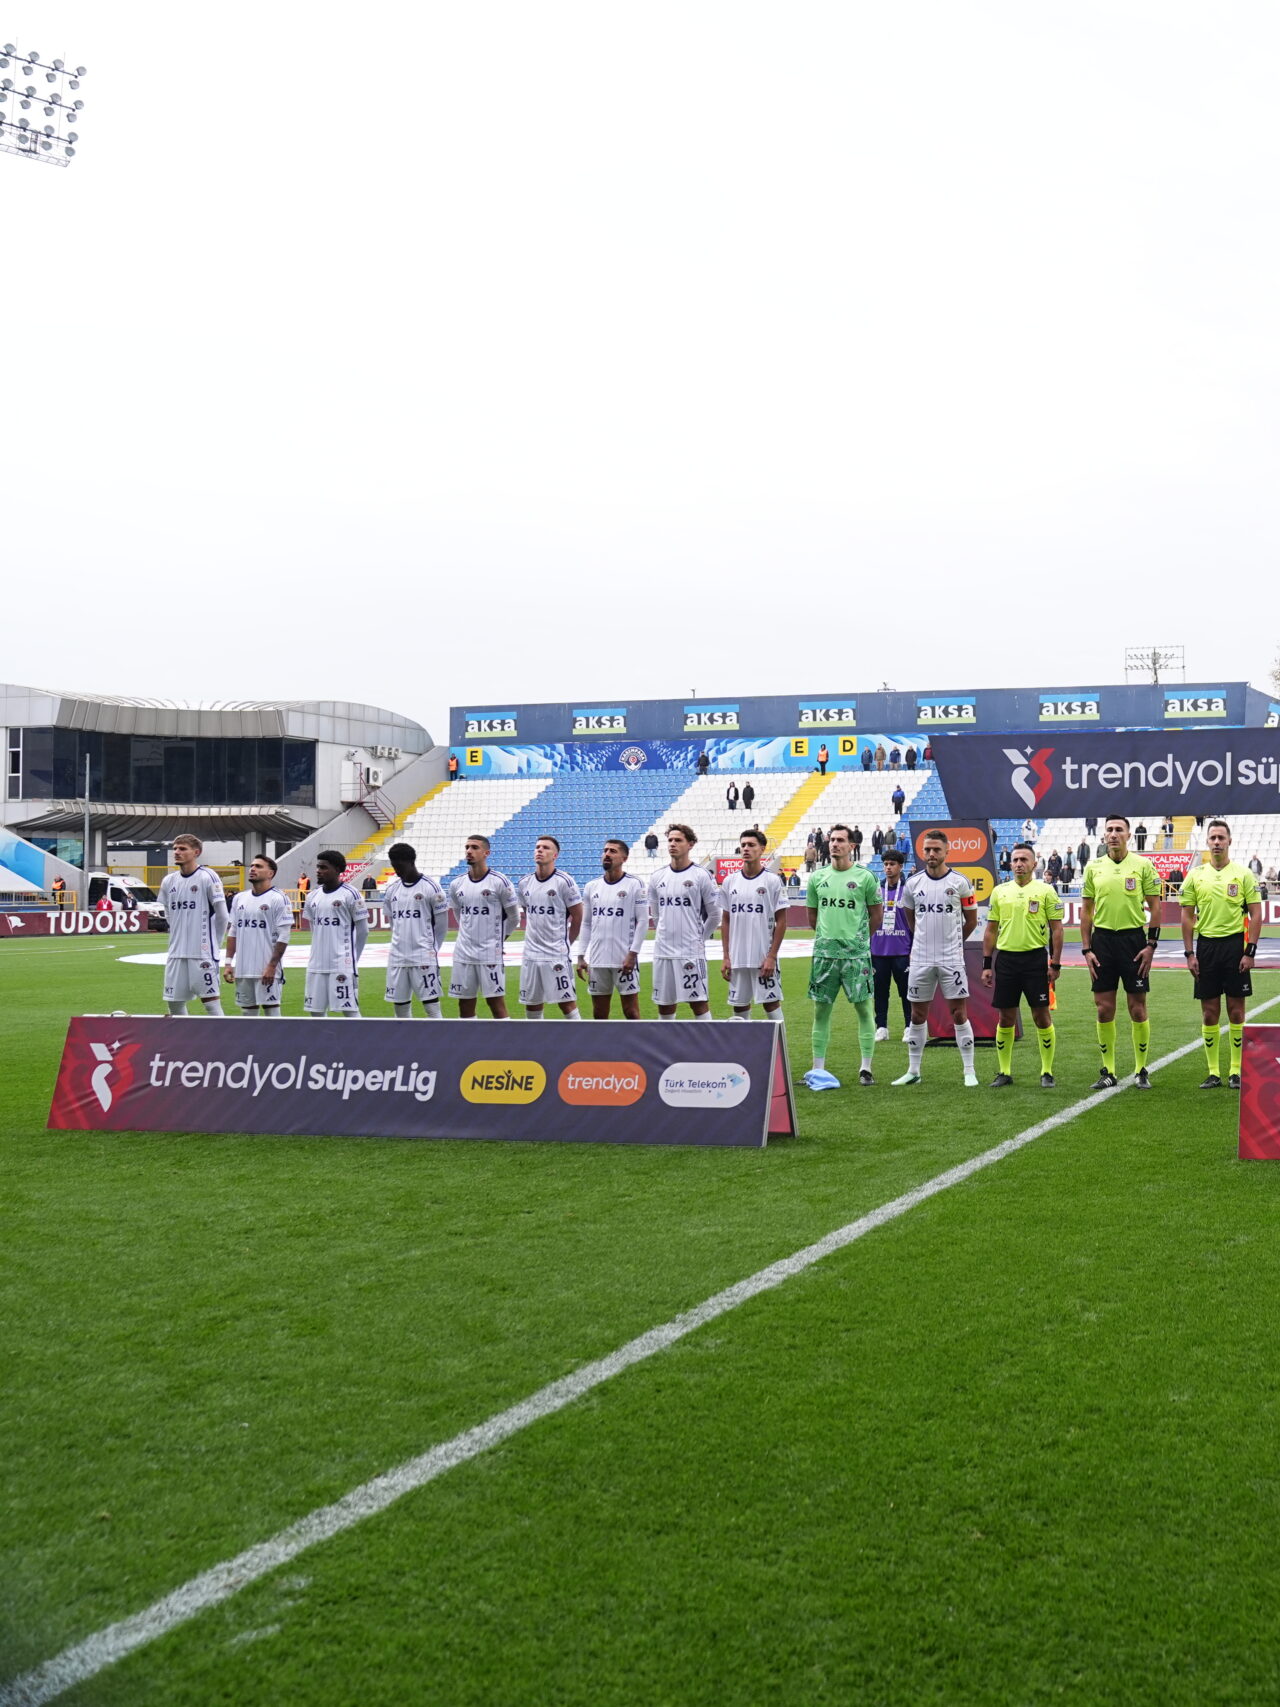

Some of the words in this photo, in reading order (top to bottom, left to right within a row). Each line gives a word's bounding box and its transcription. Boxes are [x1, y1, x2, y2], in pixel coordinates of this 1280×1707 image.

[920, 704, 974, 719] aksa
[1041, 701, 1098, 716] aksa
[1166, 698, 1225, 712] aksa
[574, 716, 626, 728] aksa
[685, 712, 738, 726] aksa
[801, 708, 854, 722] aksa
[467, 720, 516, 732] aksa
[795, 740, 804, 754] E
[842, 740, 854, 752] D
[470, 750, 478, 762] E
[1062, 752, 1232, 794] trendyol
[660, 896, 692, 907] aksa
[821, 897, 856, 910] aksa
[968, 896, 974, 905] C
[592, 906, 624, 917] aksa
[731, 903, 764, 913] aksa
[919, 903, 954, 913] aksa
[46, 911, 140, 934] TUDORS
[238, 919, 267, 928] aksa
[204, 973, 212, 986] 9
[422, 973, 436, 988] 17
[490, 972, 498, 985] 4
[556, 976, 569, 990] 16
[683, 974, 699, 990] 27
[953, 970, 962, 986] 2
[336, 986, 350, 1000] 51
[150, 1054, 306, 1096] trendyol
[308, 1062, 437, 1102] SüperLig
[568, 1073, 639, 1094] trendyol
[664, 1079, 684, 1088] Türk
[688, 1079, 727, 1088] Telekom
